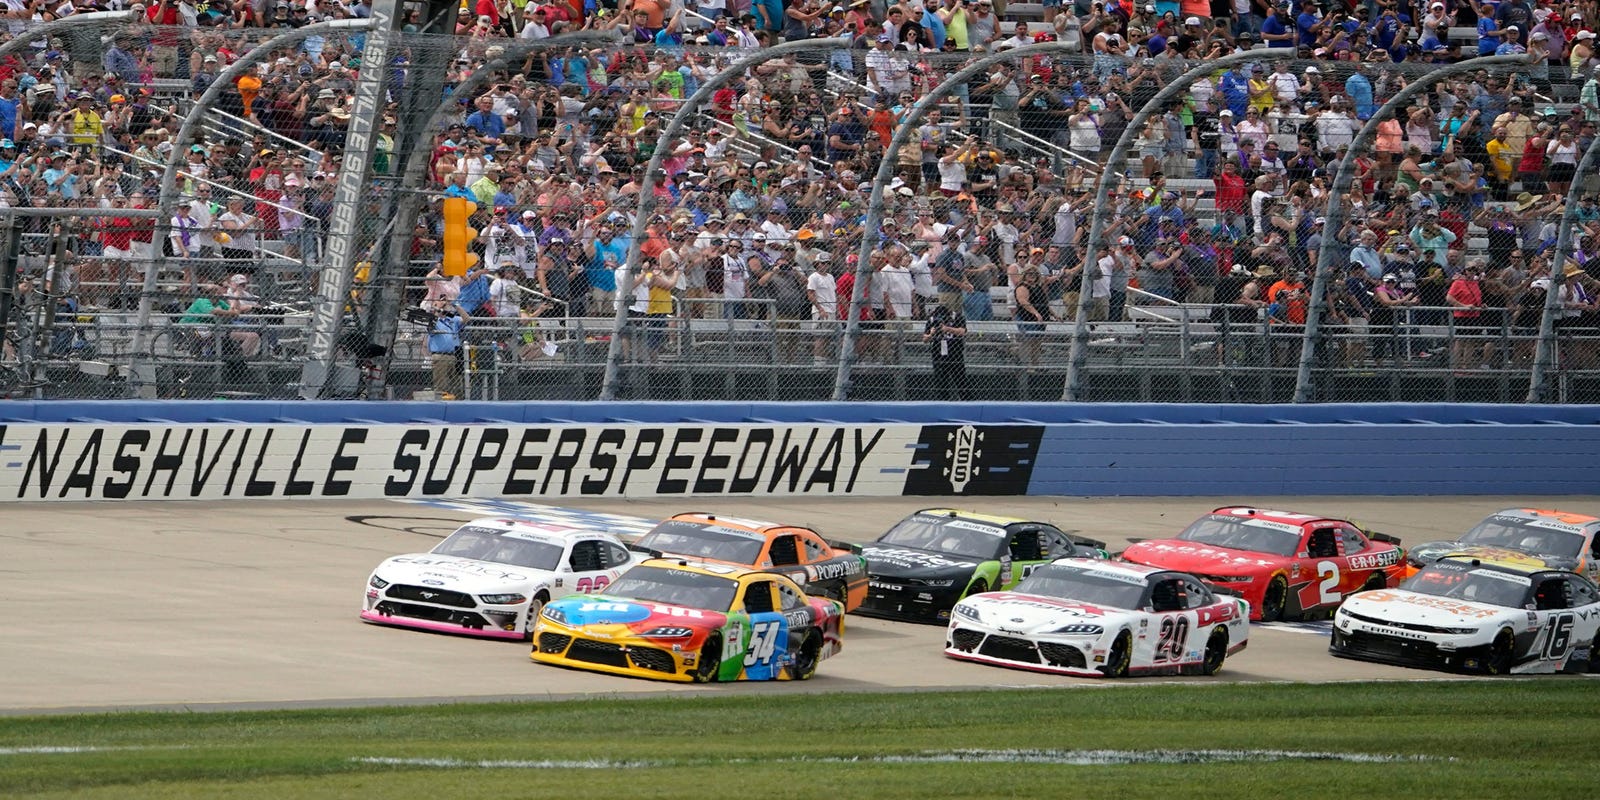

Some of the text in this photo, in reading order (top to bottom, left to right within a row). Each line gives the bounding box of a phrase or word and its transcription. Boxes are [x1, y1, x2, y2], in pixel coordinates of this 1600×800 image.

[310, 10, 389, 367] NASHVILLE SUPERSPEEDWAY
[17, 427, 886, 499] NASHVILLE SUPERSPEEDWAY
[954, 429, 973, 483] NSS
[962, 522, 1000, 534] BURTON
[815, 564, 845, 580] POPPY
[1317, 560, 1342, 605] 2
[743, 620, 780, 667] 54
[1153, 613, 1190, 664] 20
[1361, 624, 1428, 640] CAMARO
[1540, 611, 1575, 661] 16
